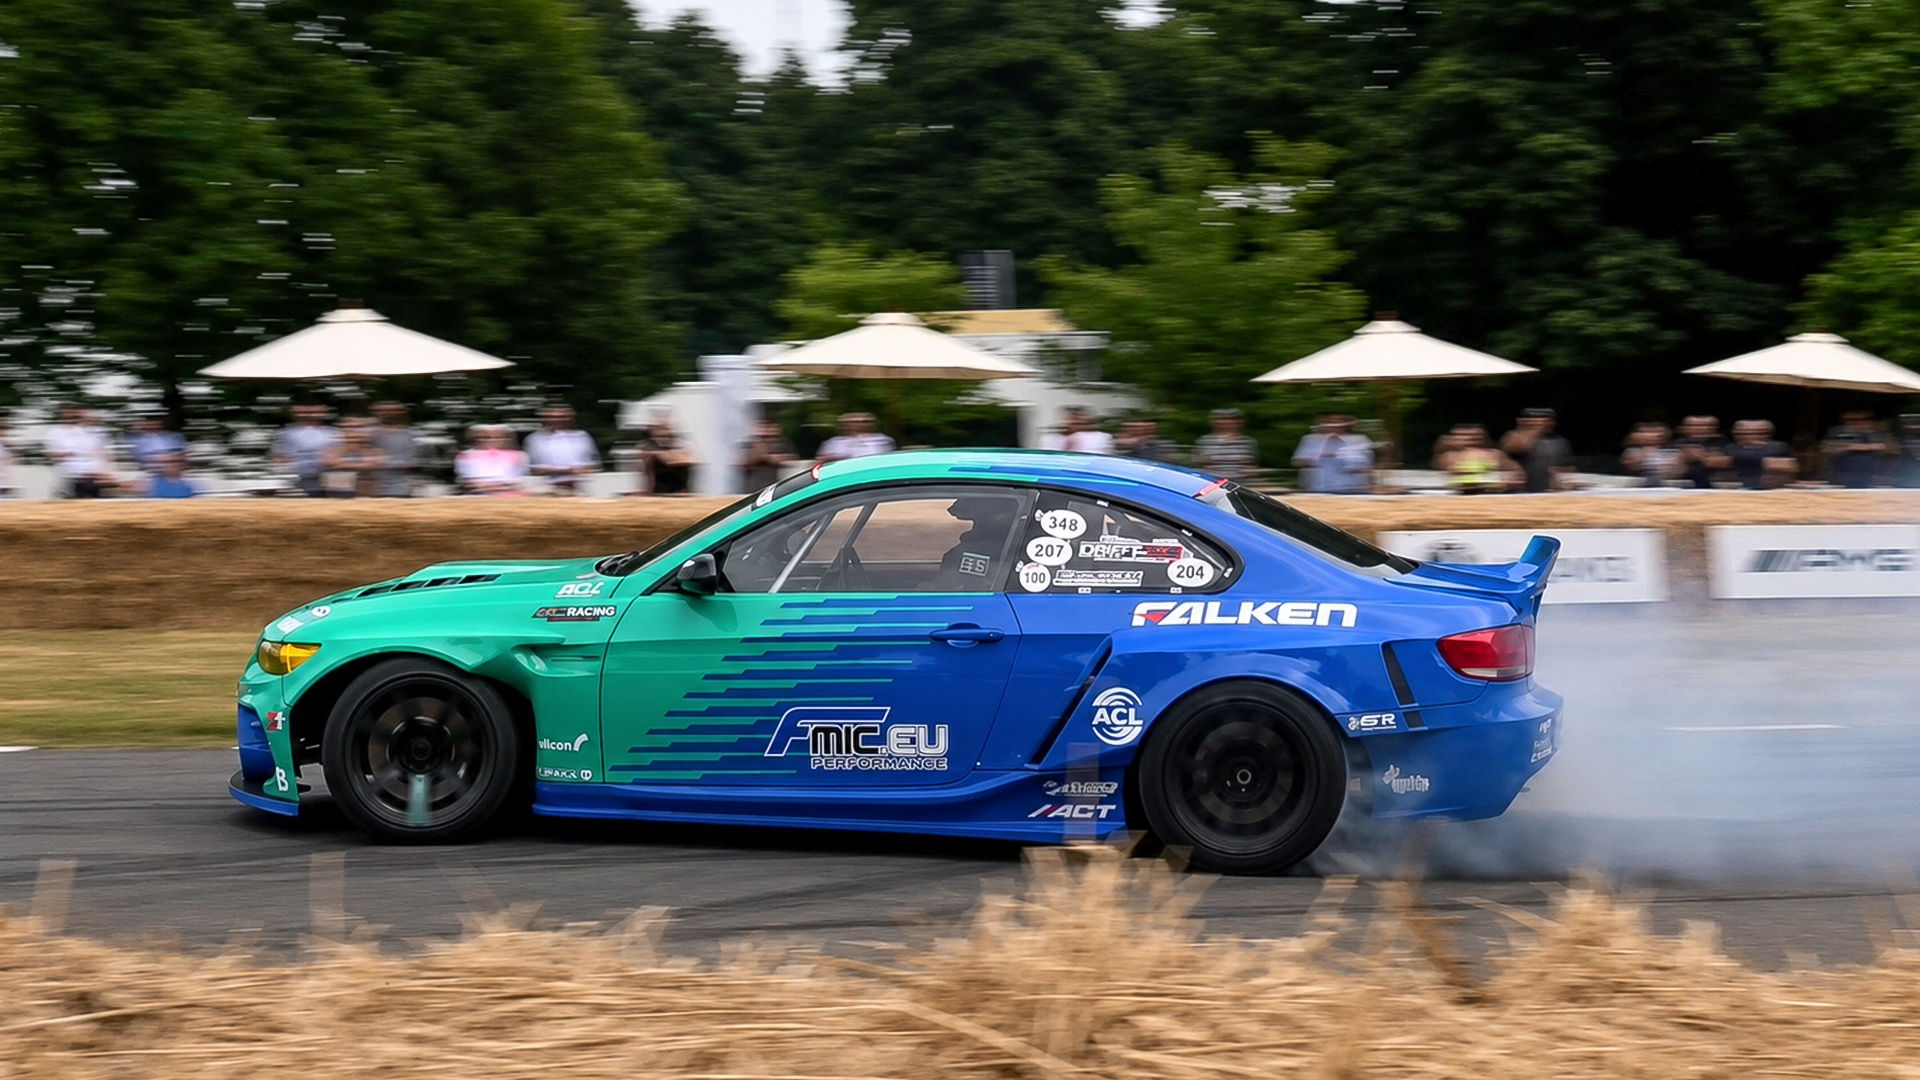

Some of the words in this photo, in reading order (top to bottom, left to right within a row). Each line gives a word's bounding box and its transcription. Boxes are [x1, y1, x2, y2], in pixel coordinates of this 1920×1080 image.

[1048, 516, 1078, 531] 348
[1034, 544, 1065, 558] 207
[1024, 572, 1046, 583] 100
[1176, 565, 1204, 579] 204
[566, 606, 615, 616] RACING
[1131, 601, 1358, 627] FALKEN
[1091, 708, 1143, 725] ACL
[811, 757, 949, 770] PERFORMANCE
[1047, 805, 1116, 819] ACT
